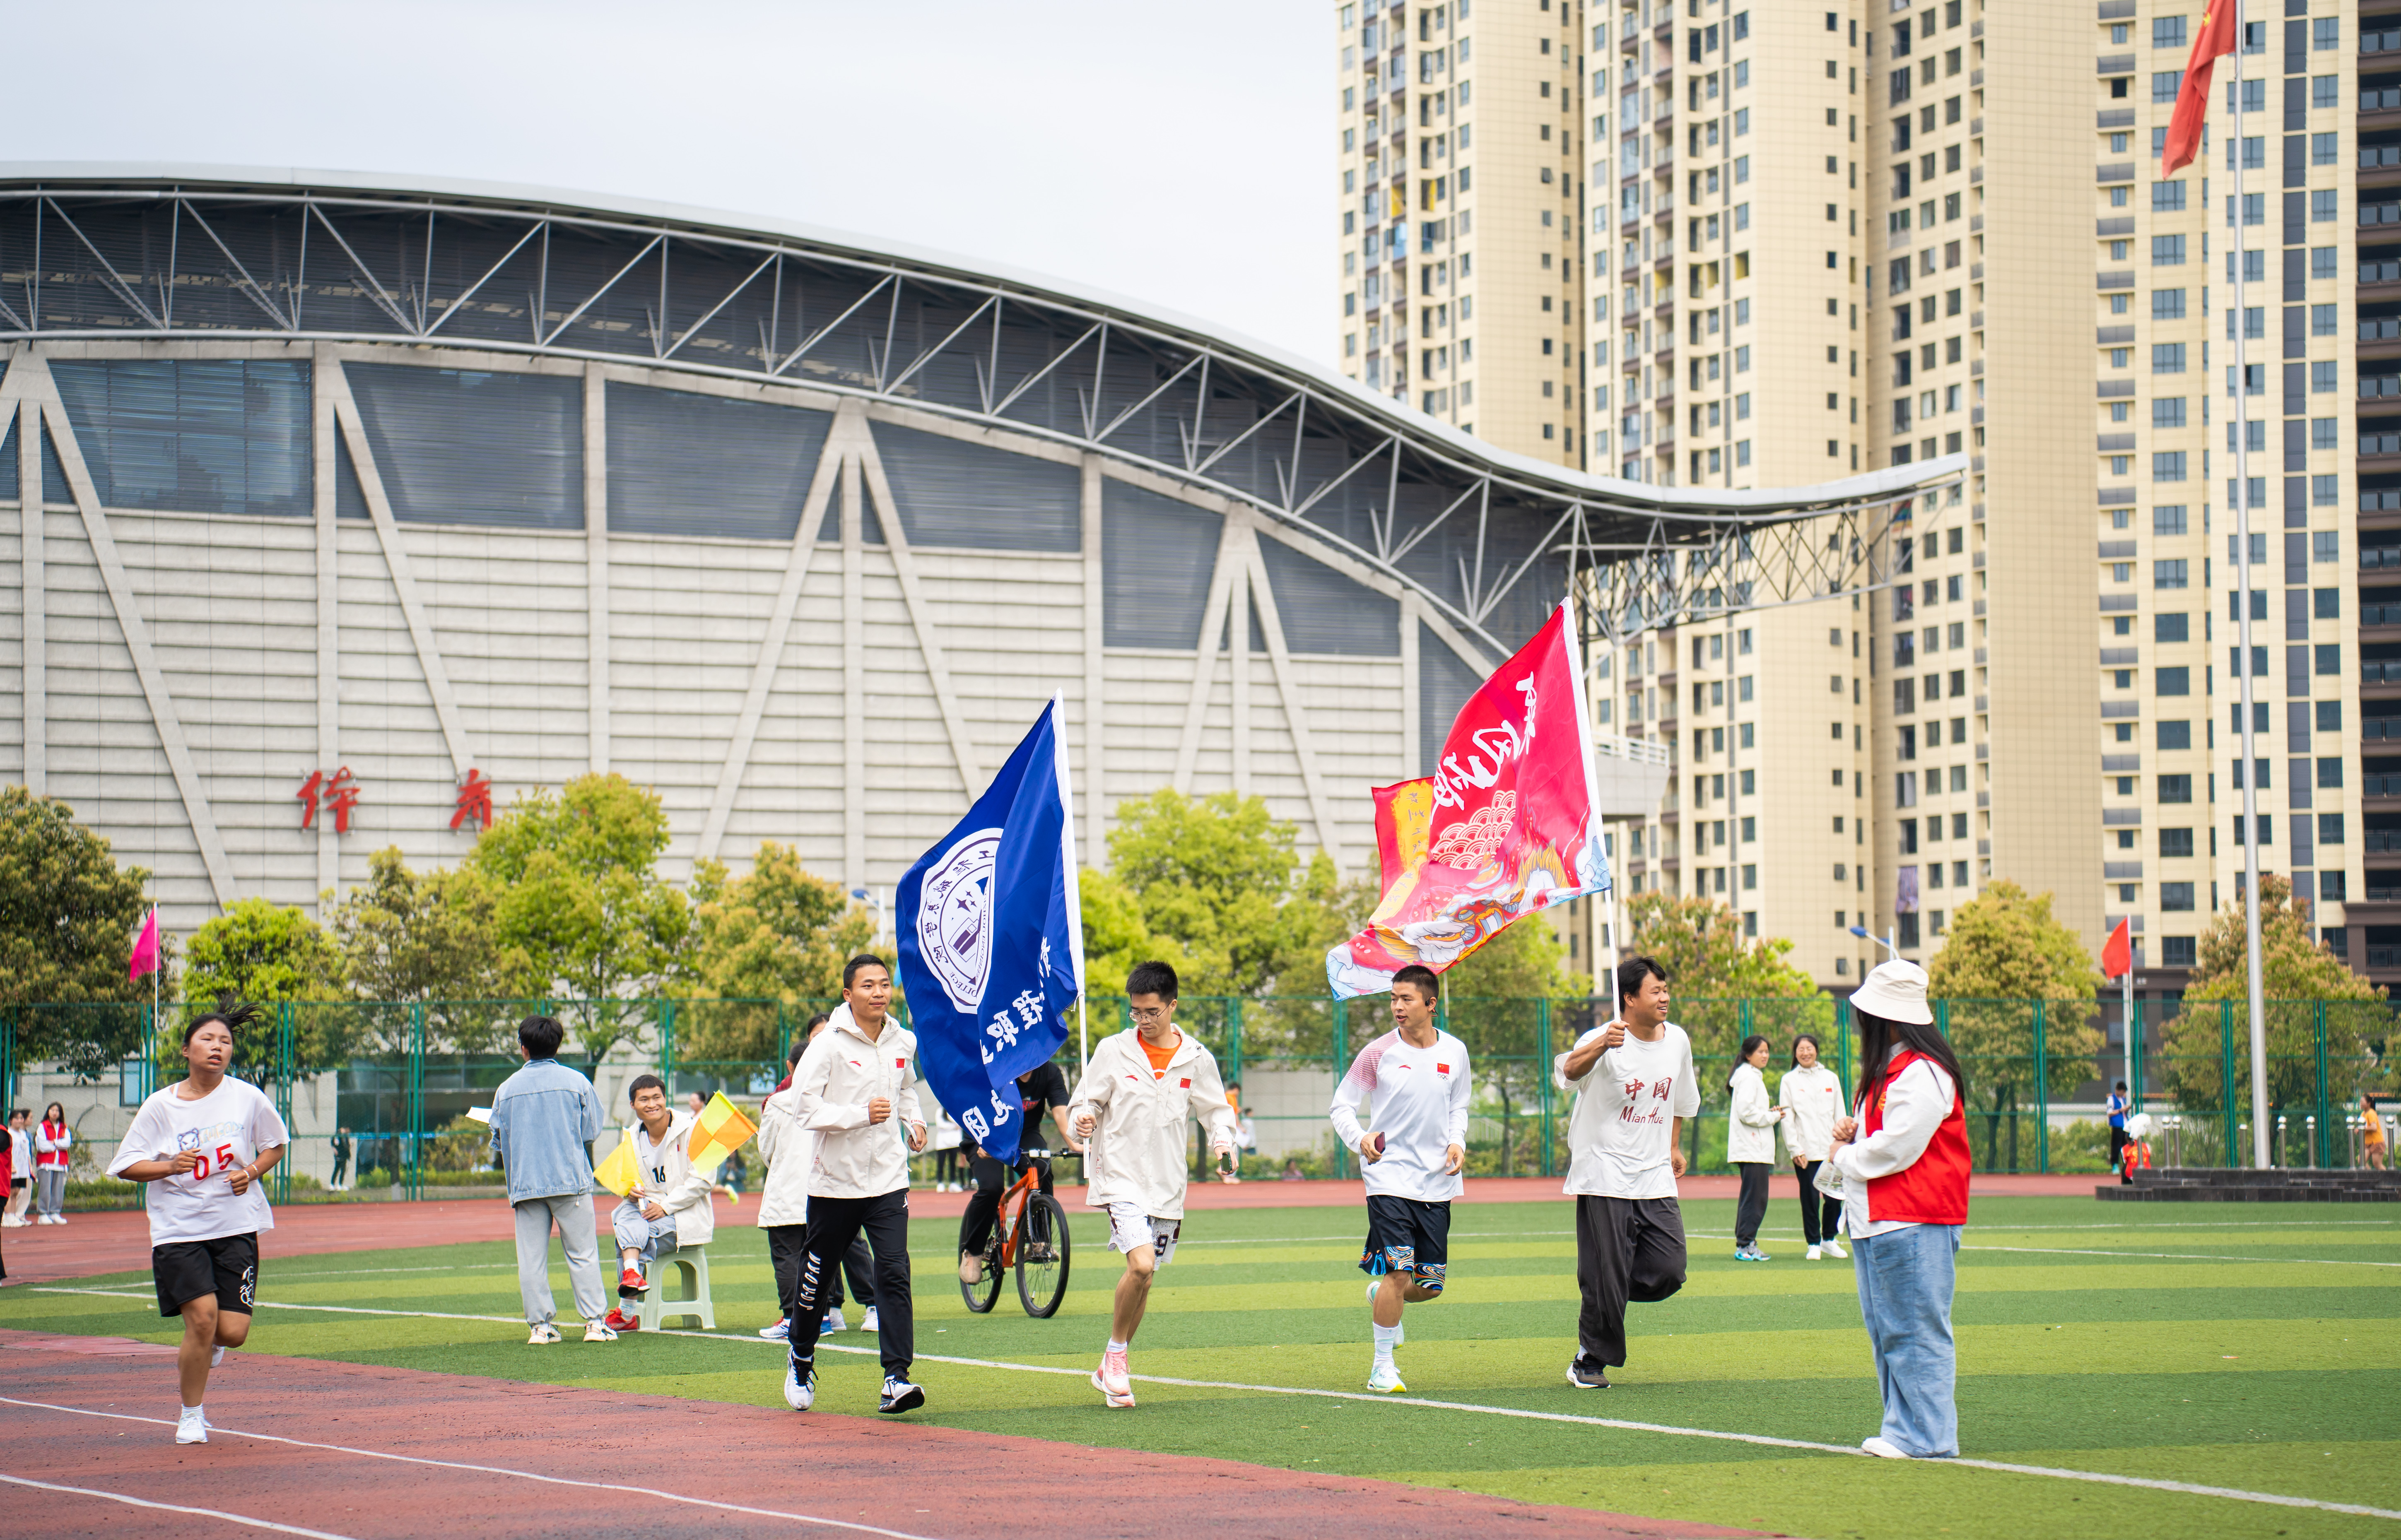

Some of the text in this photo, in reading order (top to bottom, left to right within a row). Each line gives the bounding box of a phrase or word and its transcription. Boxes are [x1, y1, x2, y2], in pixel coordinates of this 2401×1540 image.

[1625, 1077, 1672, 1101] 中國
[1619, 1106, 1663, 1124] Mian Hua
[652, 1165, 666, 1183] 16
[798, 1250, 821, 1310] JORDAN
